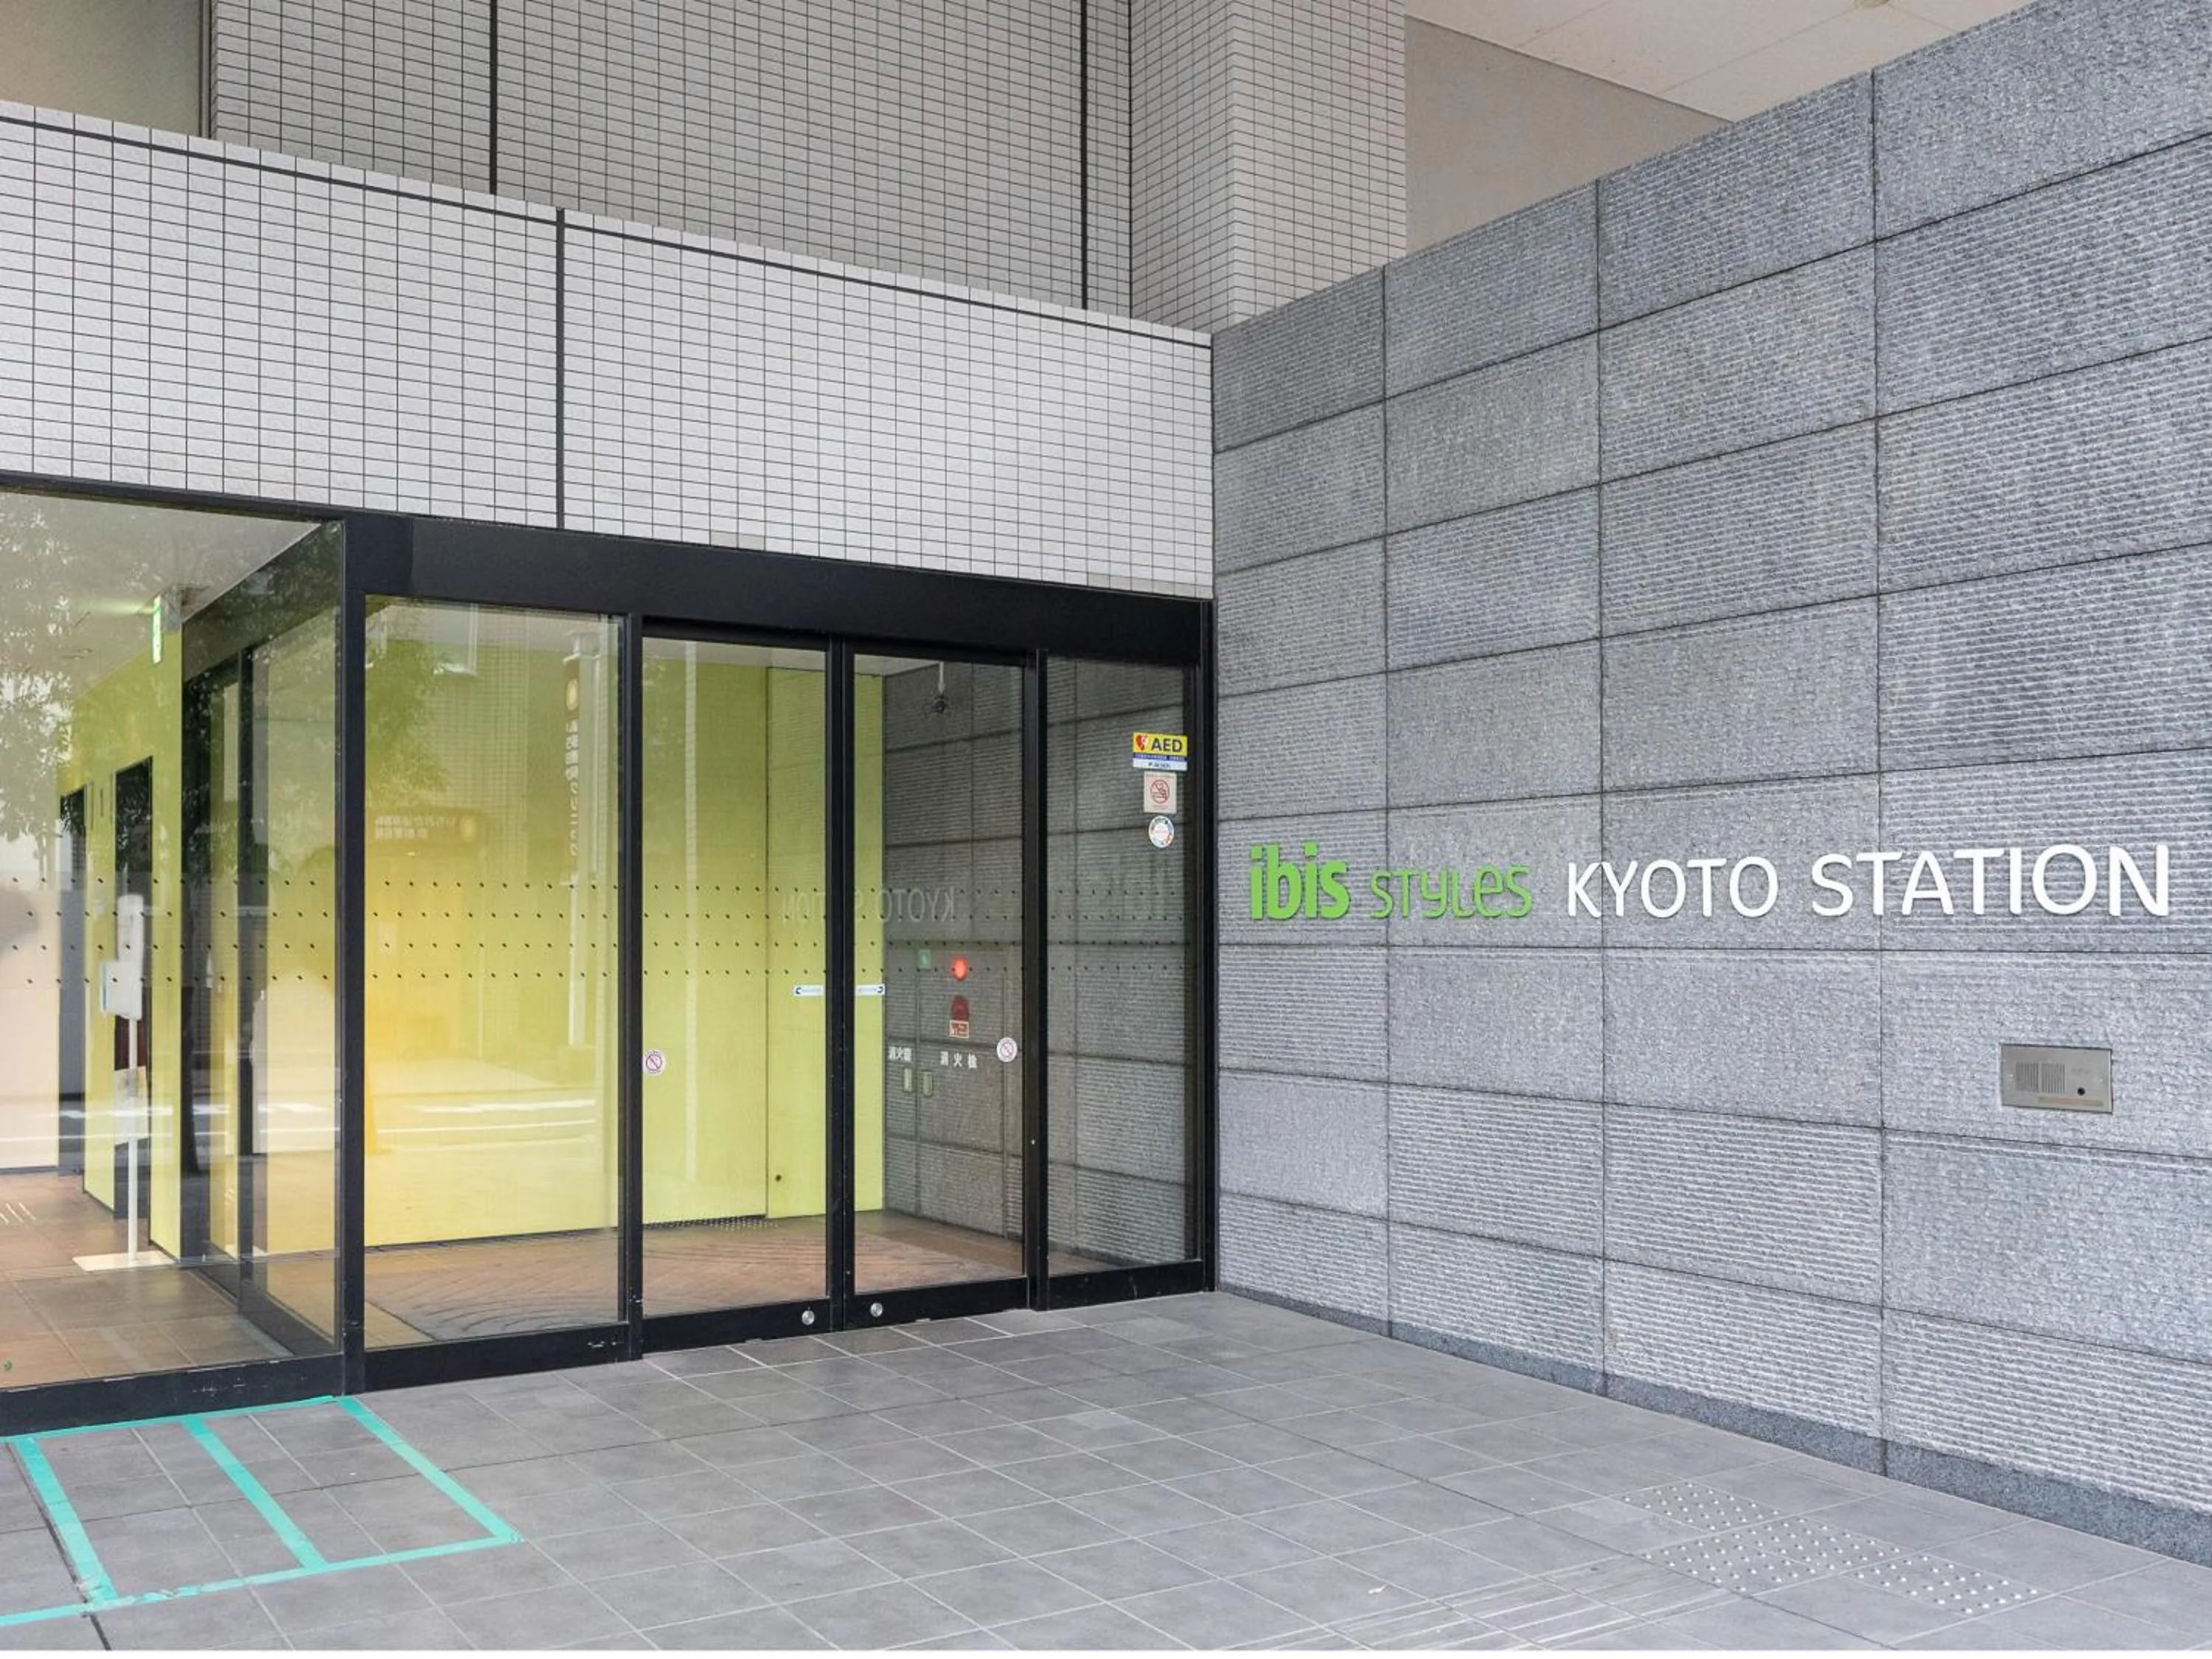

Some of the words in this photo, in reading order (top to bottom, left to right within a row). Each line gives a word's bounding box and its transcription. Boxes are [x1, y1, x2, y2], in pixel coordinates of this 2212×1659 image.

[1151, 737, 1183, 753] AED
[1250, 841, 1351, 921] ibis
[1568, 855, 1779, 919] KYOTO
[1811, 844, 2170, 917] STATION
